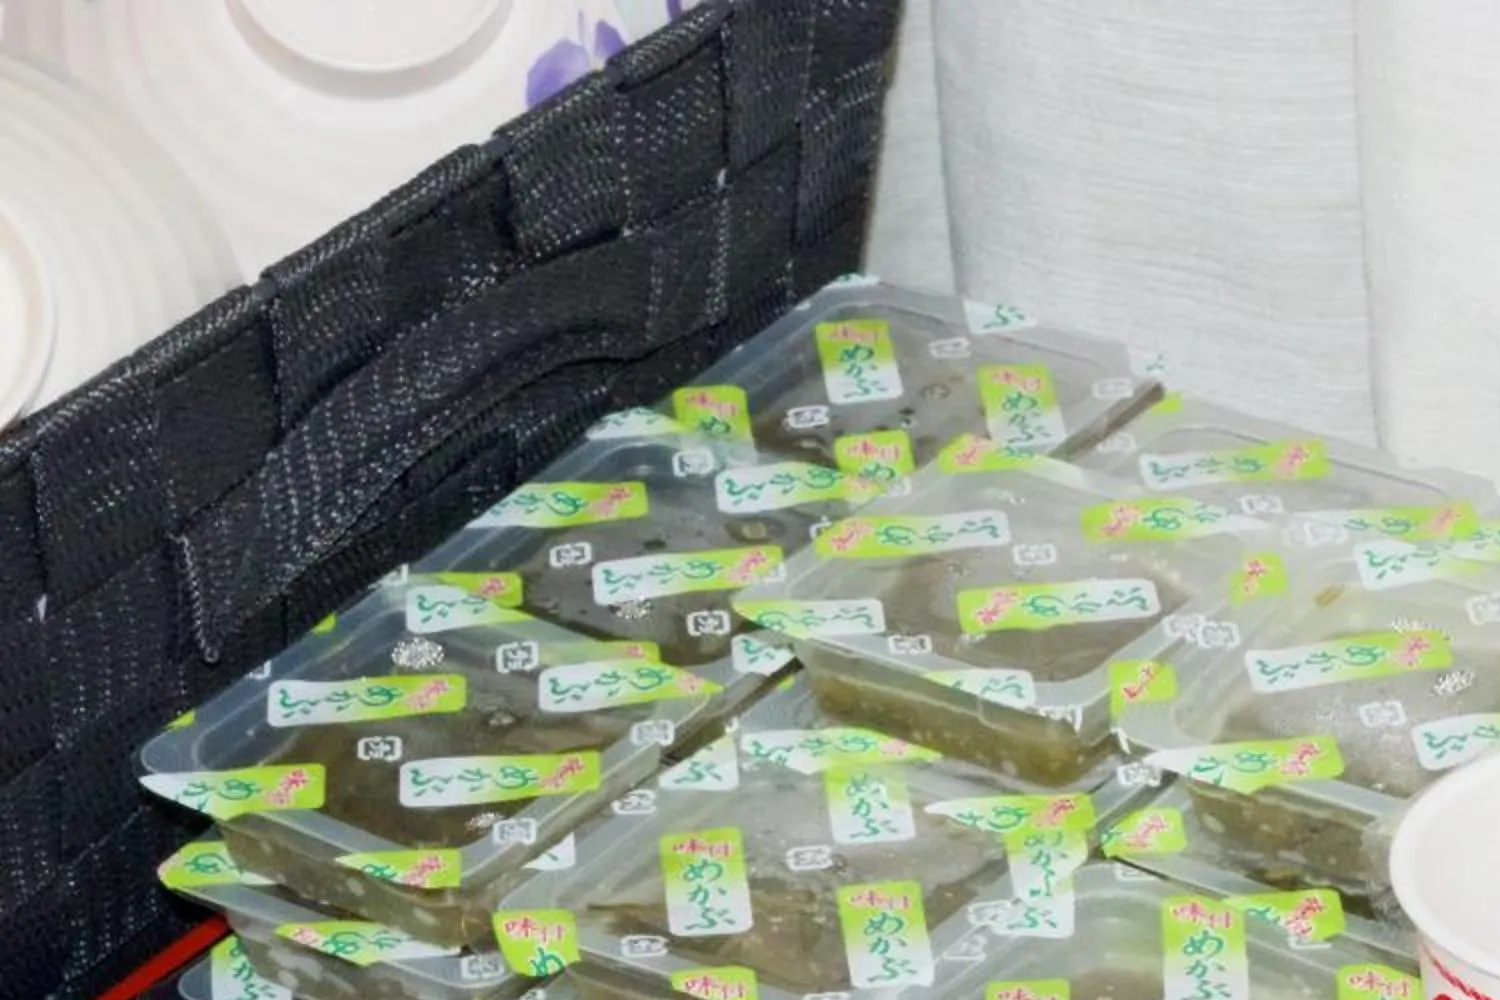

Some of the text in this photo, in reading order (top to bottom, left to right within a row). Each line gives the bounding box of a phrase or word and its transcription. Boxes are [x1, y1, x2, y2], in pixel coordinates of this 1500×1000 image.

[176, 779, 261, 811] めか
[683, 859, 736, 930] めかぶ
[864, 912, 918, 982] めかぶ
